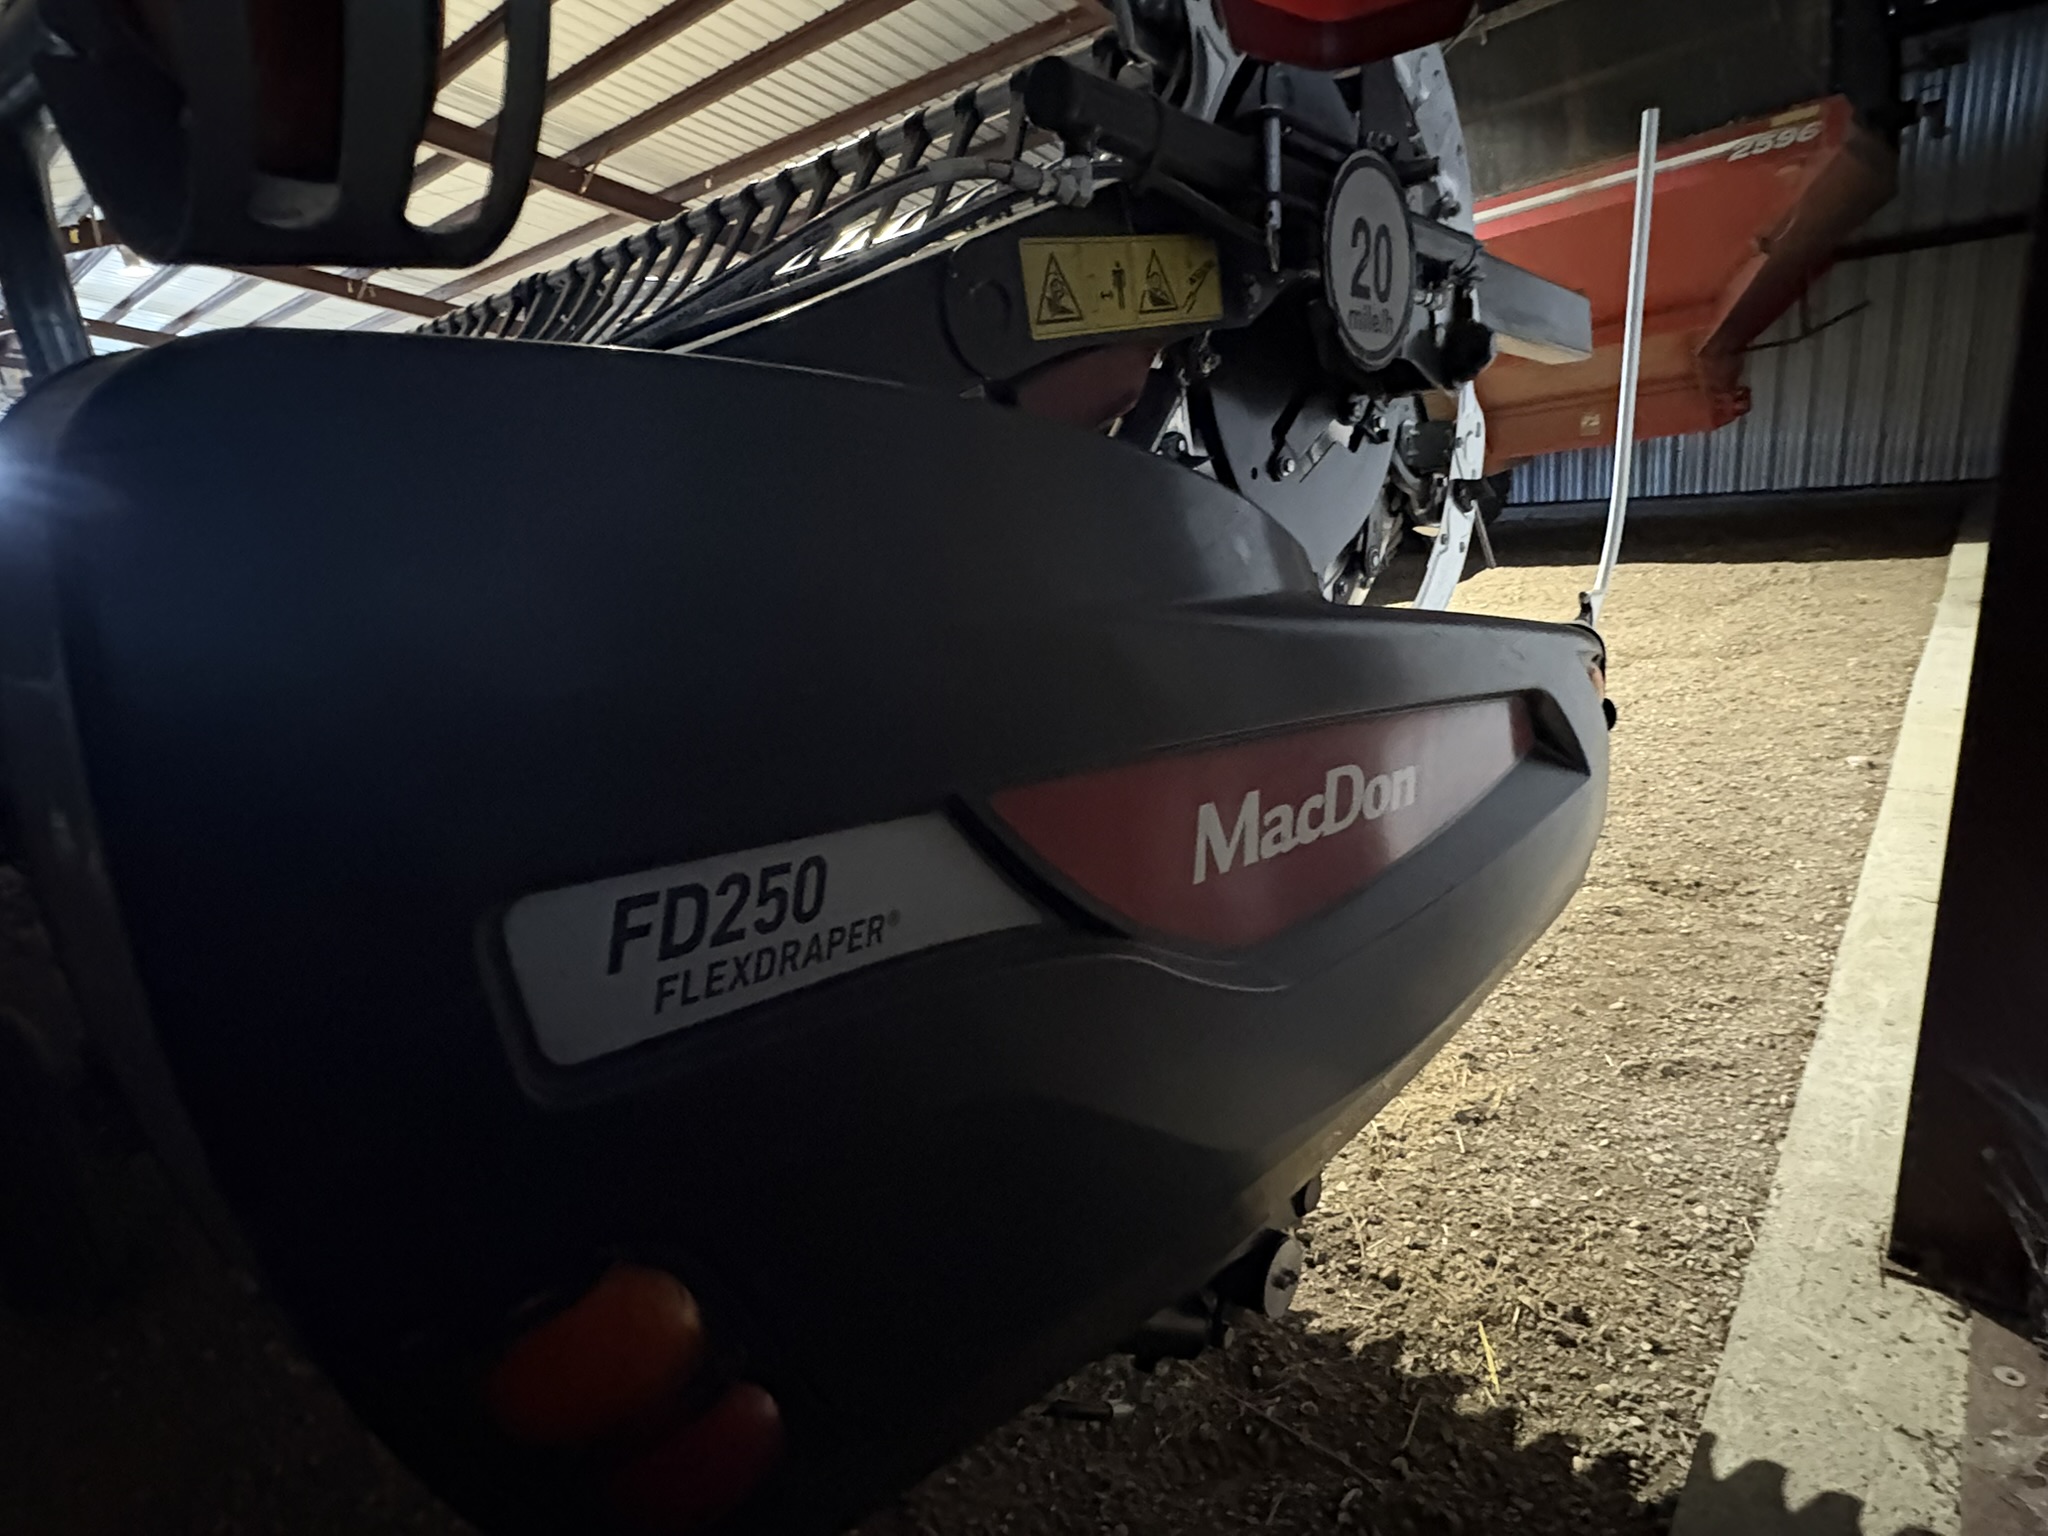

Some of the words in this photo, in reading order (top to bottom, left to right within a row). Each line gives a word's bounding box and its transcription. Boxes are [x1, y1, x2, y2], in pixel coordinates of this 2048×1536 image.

[1726, 120, 1822, 163] 2596
[1351, 216, 1393, 303] 20
[1193, 764, 1416, 885] MacDon
[607, 855, 827, 976] FD250
